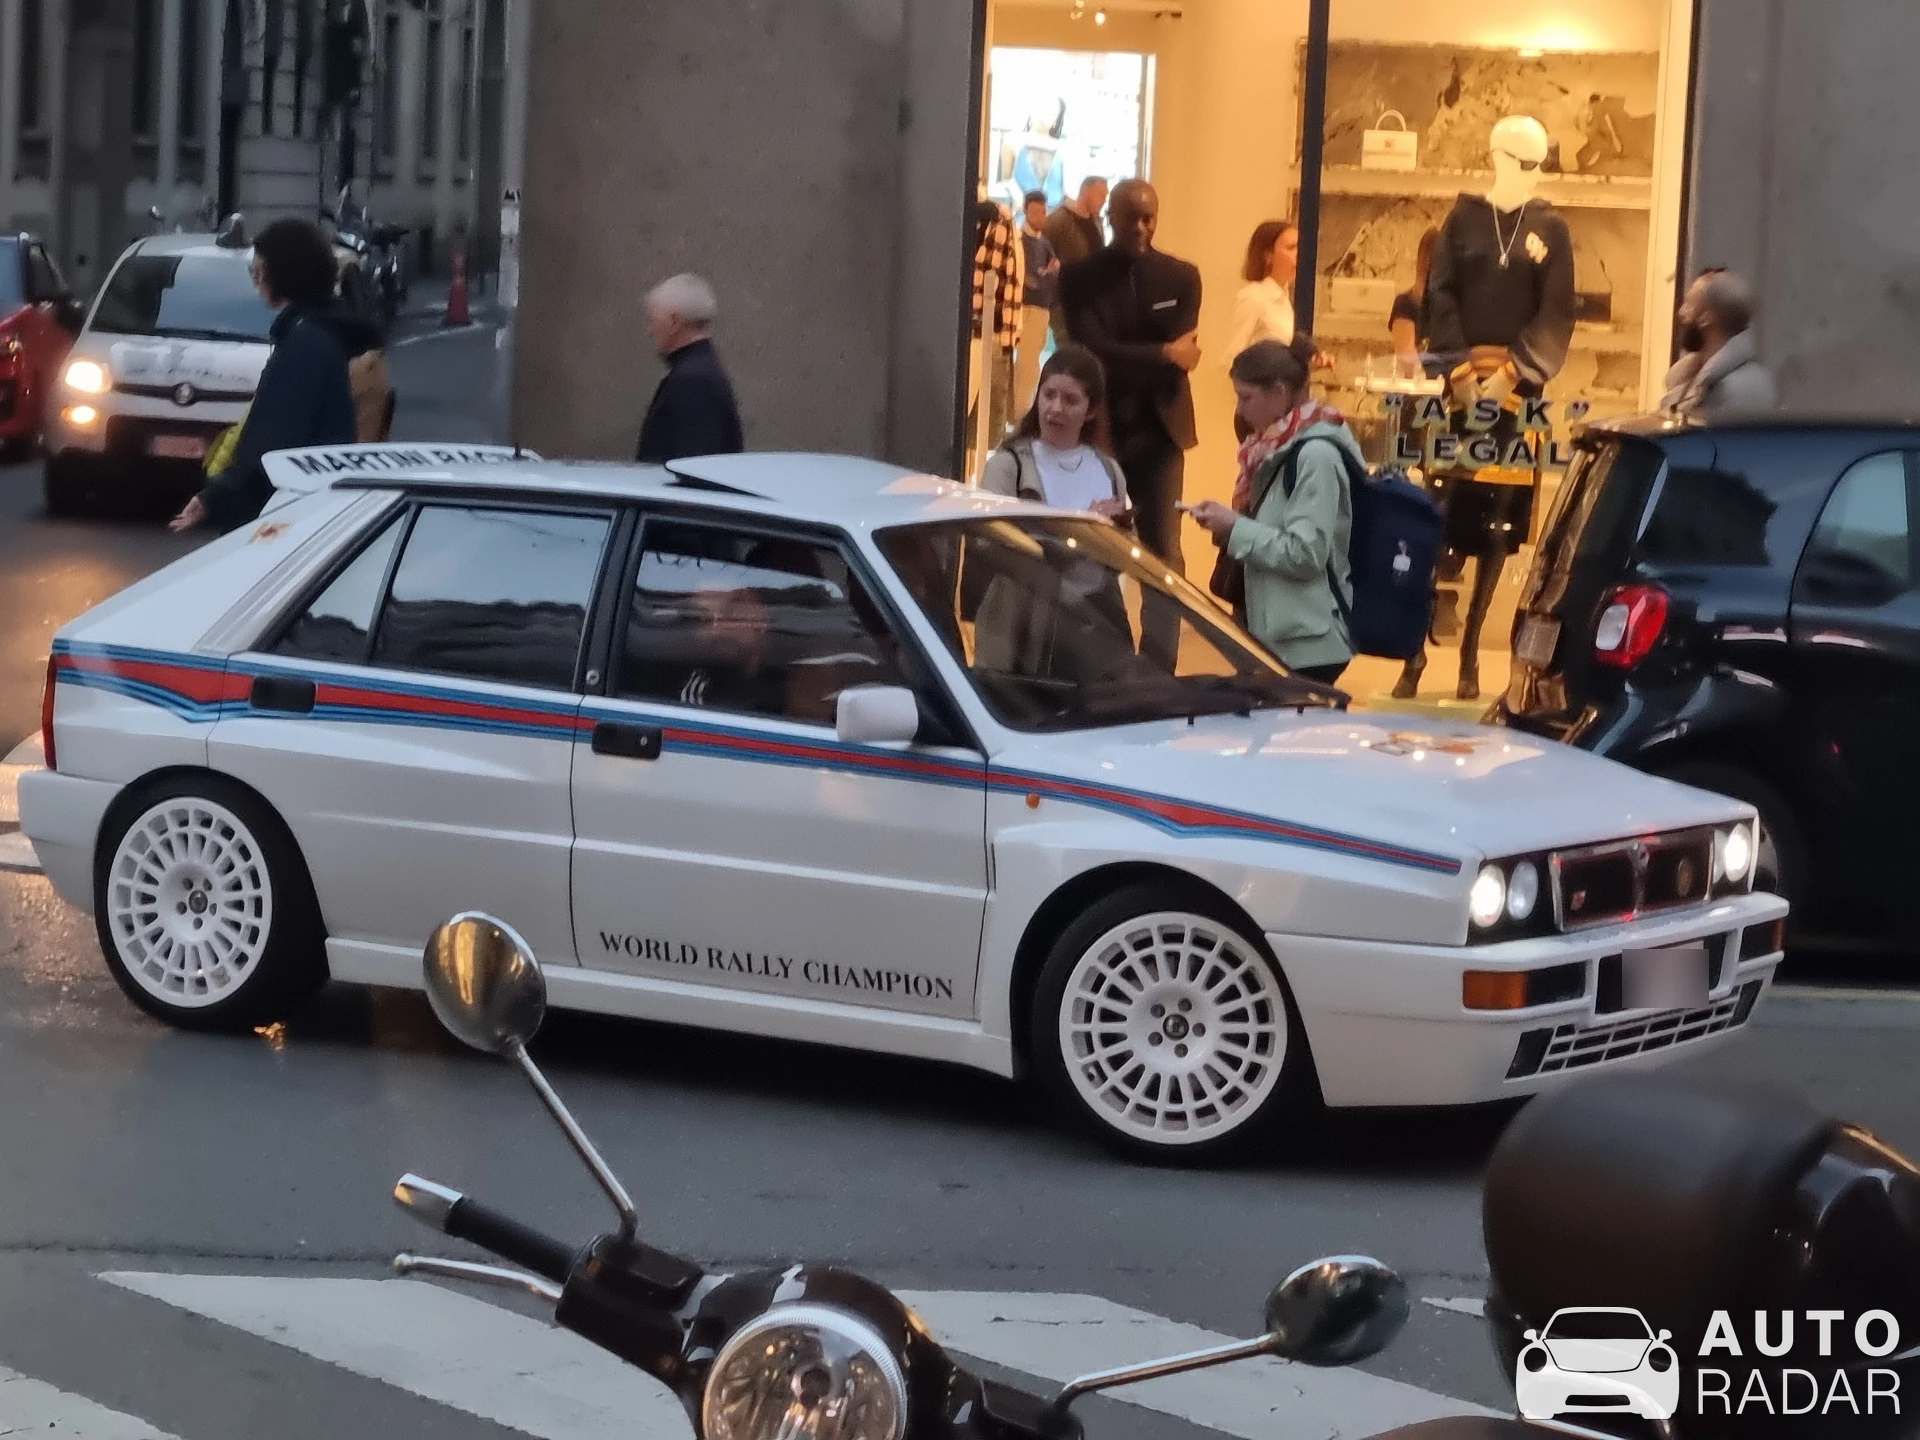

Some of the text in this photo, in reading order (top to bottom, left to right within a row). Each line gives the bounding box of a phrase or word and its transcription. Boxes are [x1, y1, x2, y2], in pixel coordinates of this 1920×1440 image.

[286, 450, 432, 475] MARTINI
[1396, 434, 1573, 466] LEGAL
[600, 931, 952, 999] WORLD RALLY CHAMPION
